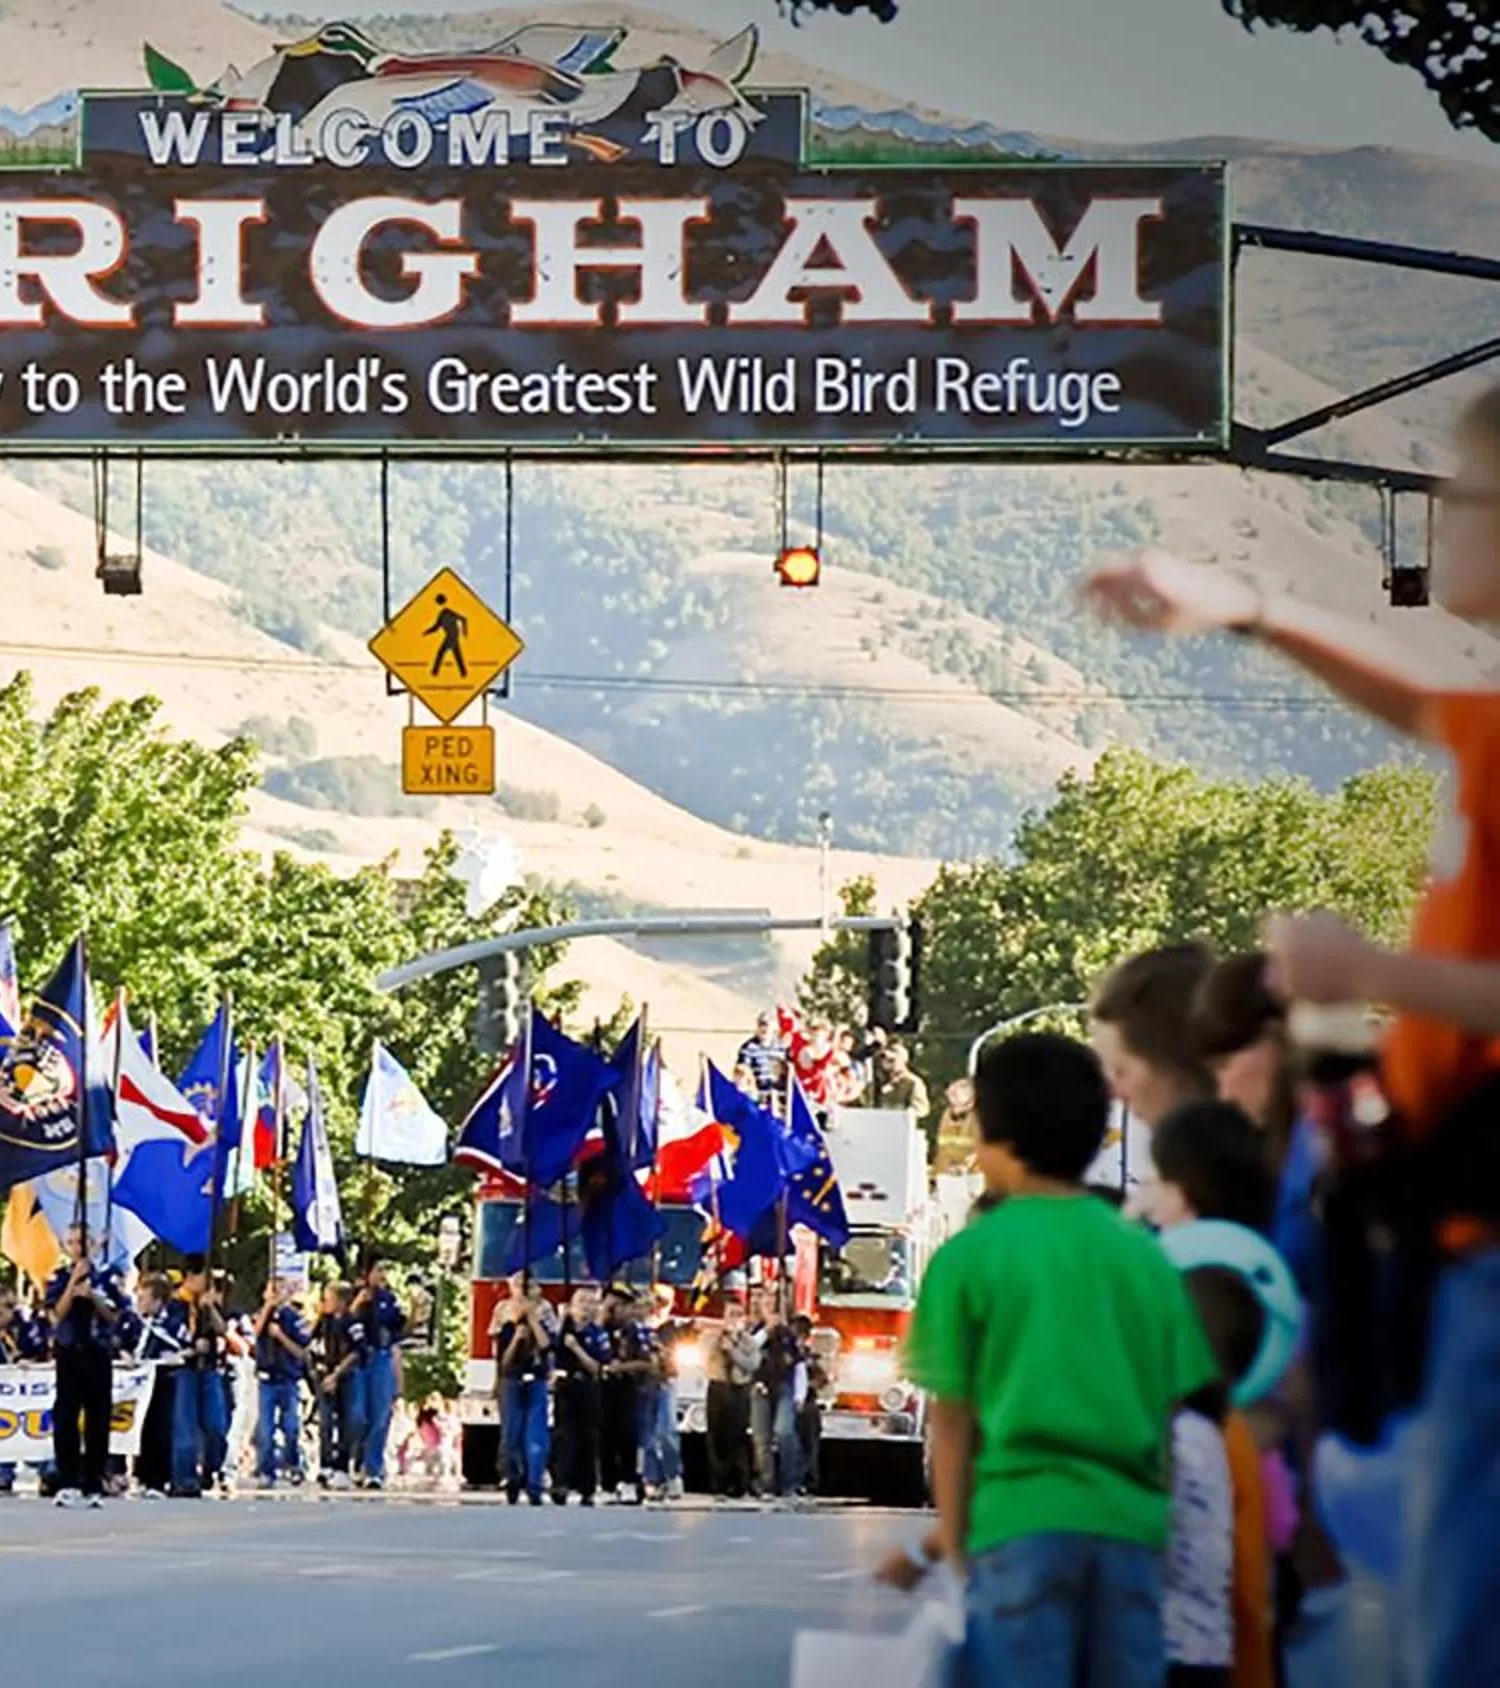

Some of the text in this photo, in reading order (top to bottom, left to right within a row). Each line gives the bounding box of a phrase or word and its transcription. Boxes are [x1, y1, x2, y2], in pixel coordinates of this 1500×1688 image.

[139, 110, 746, 168] WELCOME TO
[22, 362, 80, 413] to
[100, 358, 188, 413] the
[205, 358, 408, 413] World's
[427, 357, 658, 414] Greatest
[676, 357, 795, 413] Wild
[815, 357, 917, 413] Bird
[935, 357, 1121, 427] Refuge
[425, 735, 473, 757] PED
[420, 763, 479, 785] XING
